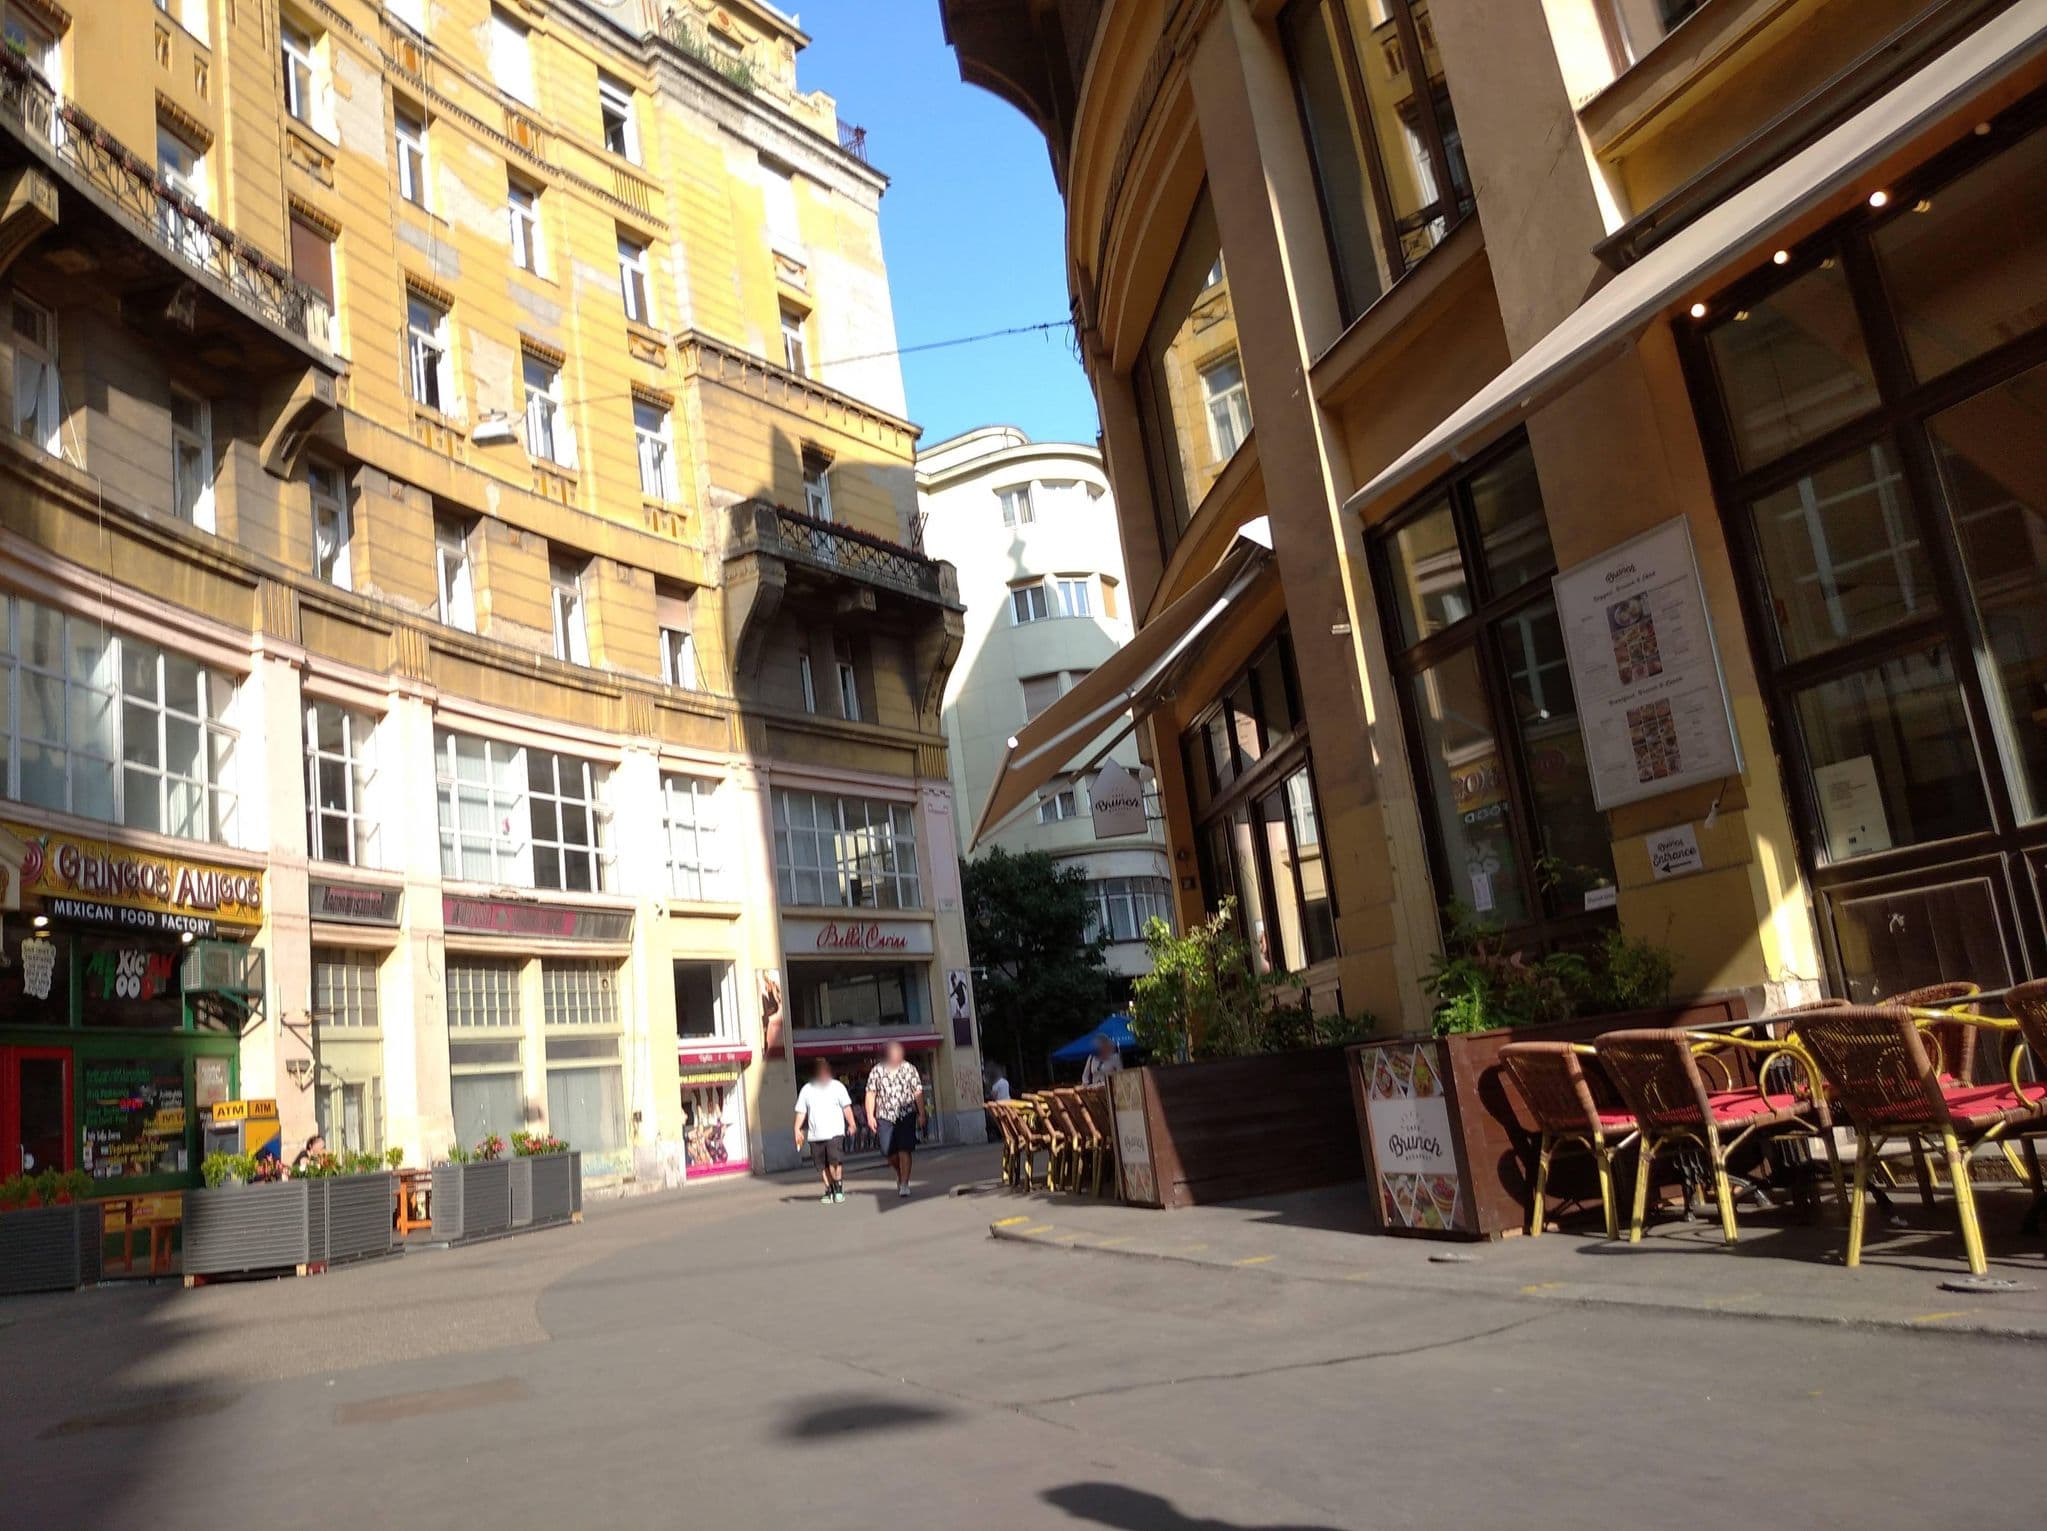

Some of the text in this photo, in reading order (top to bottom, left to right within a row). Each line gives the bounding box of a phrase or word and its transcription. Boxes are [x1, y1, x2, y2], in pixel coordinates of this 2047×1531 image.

[1095, 798, 1139, 812] Brunch
[1653, 847, 1697, 866] Entrance
[55, 843, 261, 910] GRINGOS AMIGOS
[54, 899, 210, 934] MEXICAN FOOD FACTORY
[216, 1104, 245, 1118] ATM
[253, 1102, 273, 1116] ATM
[1389, 1133, 1443, 1158] Brunch
